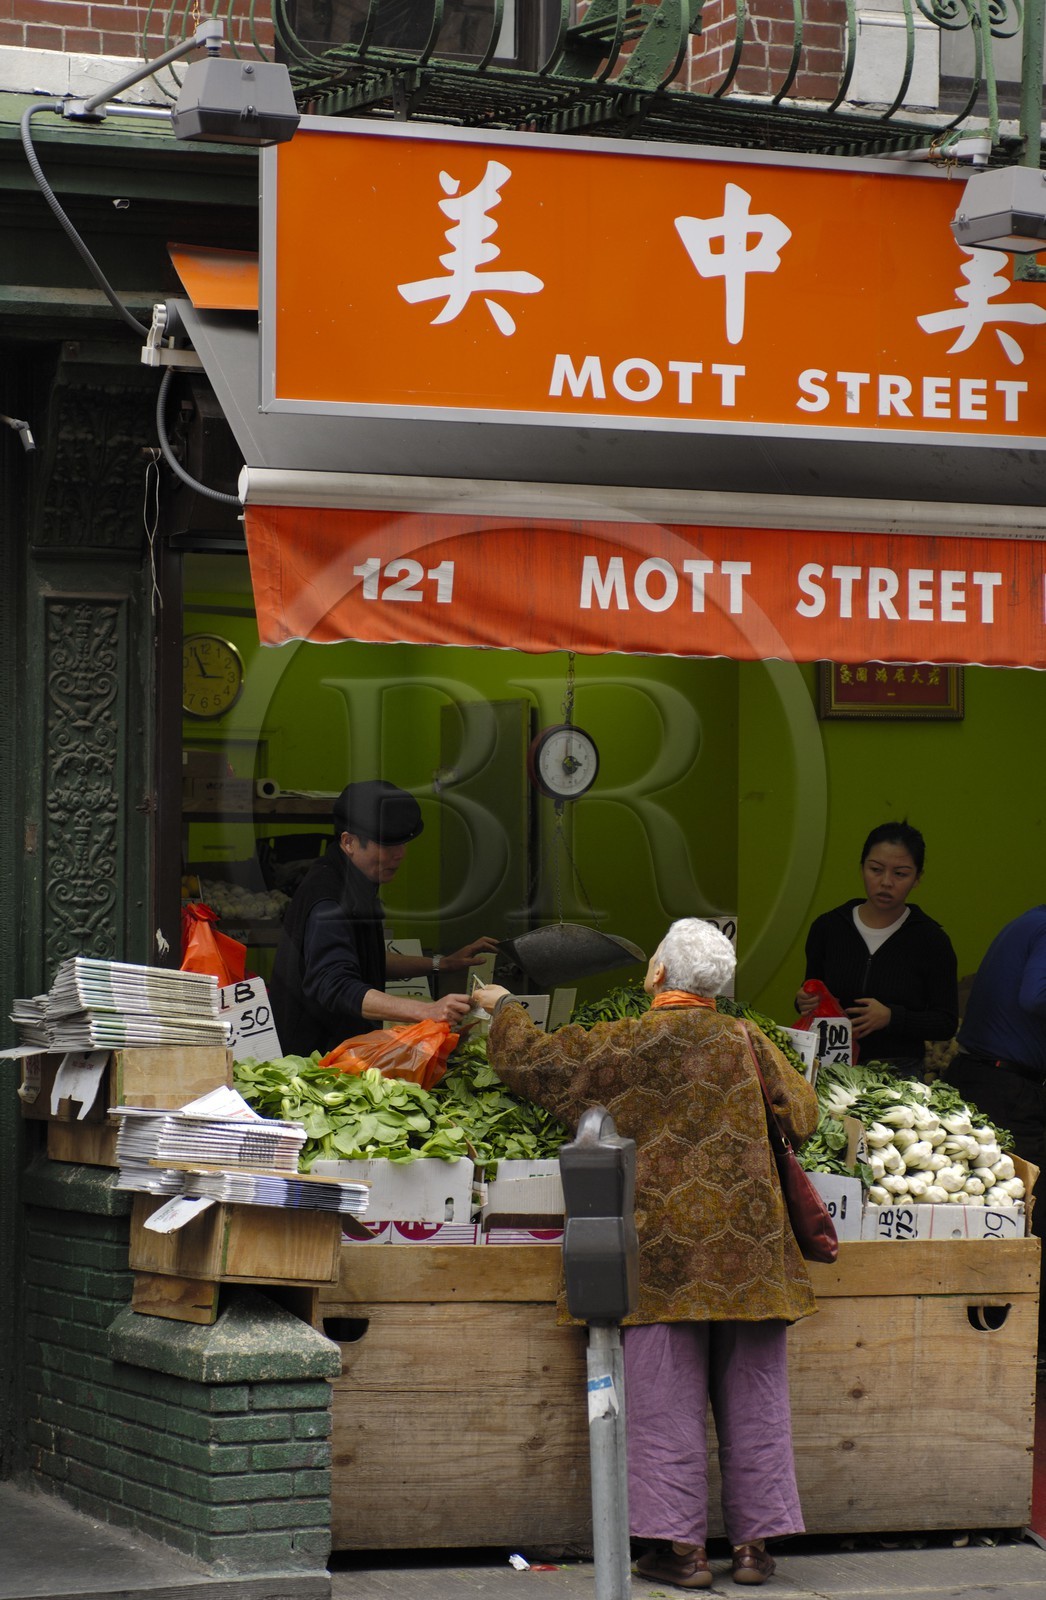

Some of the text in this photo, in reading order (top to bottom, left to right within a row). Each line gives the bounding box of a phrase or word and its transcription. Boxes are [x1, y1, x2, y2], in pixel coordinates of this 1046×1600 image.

[549, 354, 1028, 422] MOTT STREET
[353, 557, 455, 604] 121
[580, 555, 751, 614] MOTT
[796, 563, 1002, 624] STREET
[878, 1209, 894, 1238] LB
